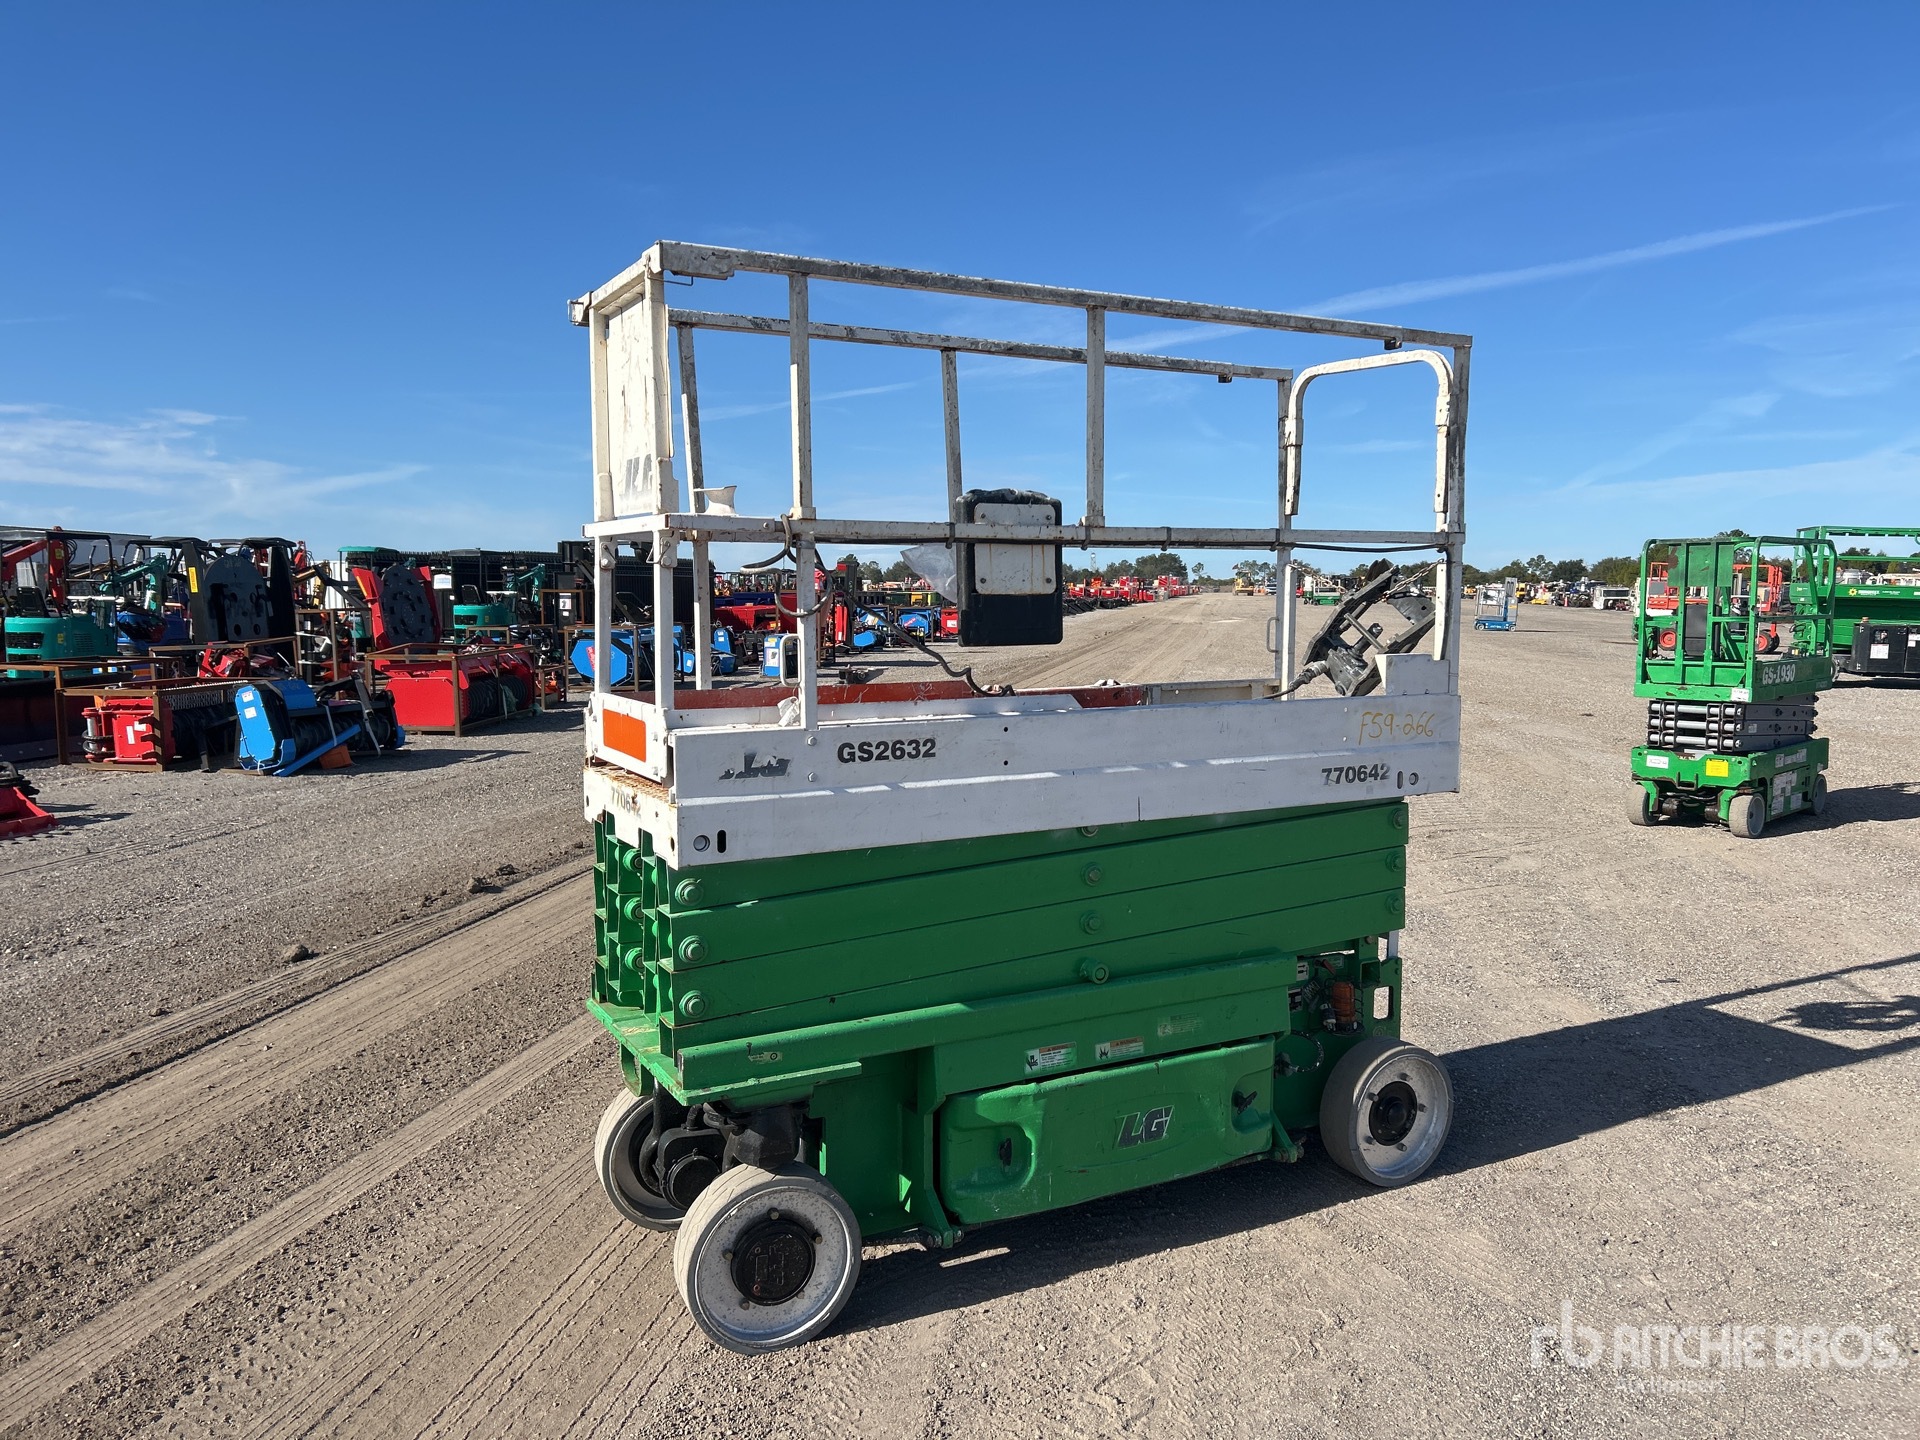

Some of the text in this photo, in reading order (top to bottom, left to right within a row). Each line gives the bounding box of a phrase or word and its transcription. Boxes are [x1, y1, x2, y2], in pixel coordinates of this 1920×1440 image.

[1762, 663, 1796, 685] GS-1930
[1358, 711, 1436, 746] F59-266
[836, 737, 937, 764] GS2632
[1321, 762, 1391, 786] 770642
